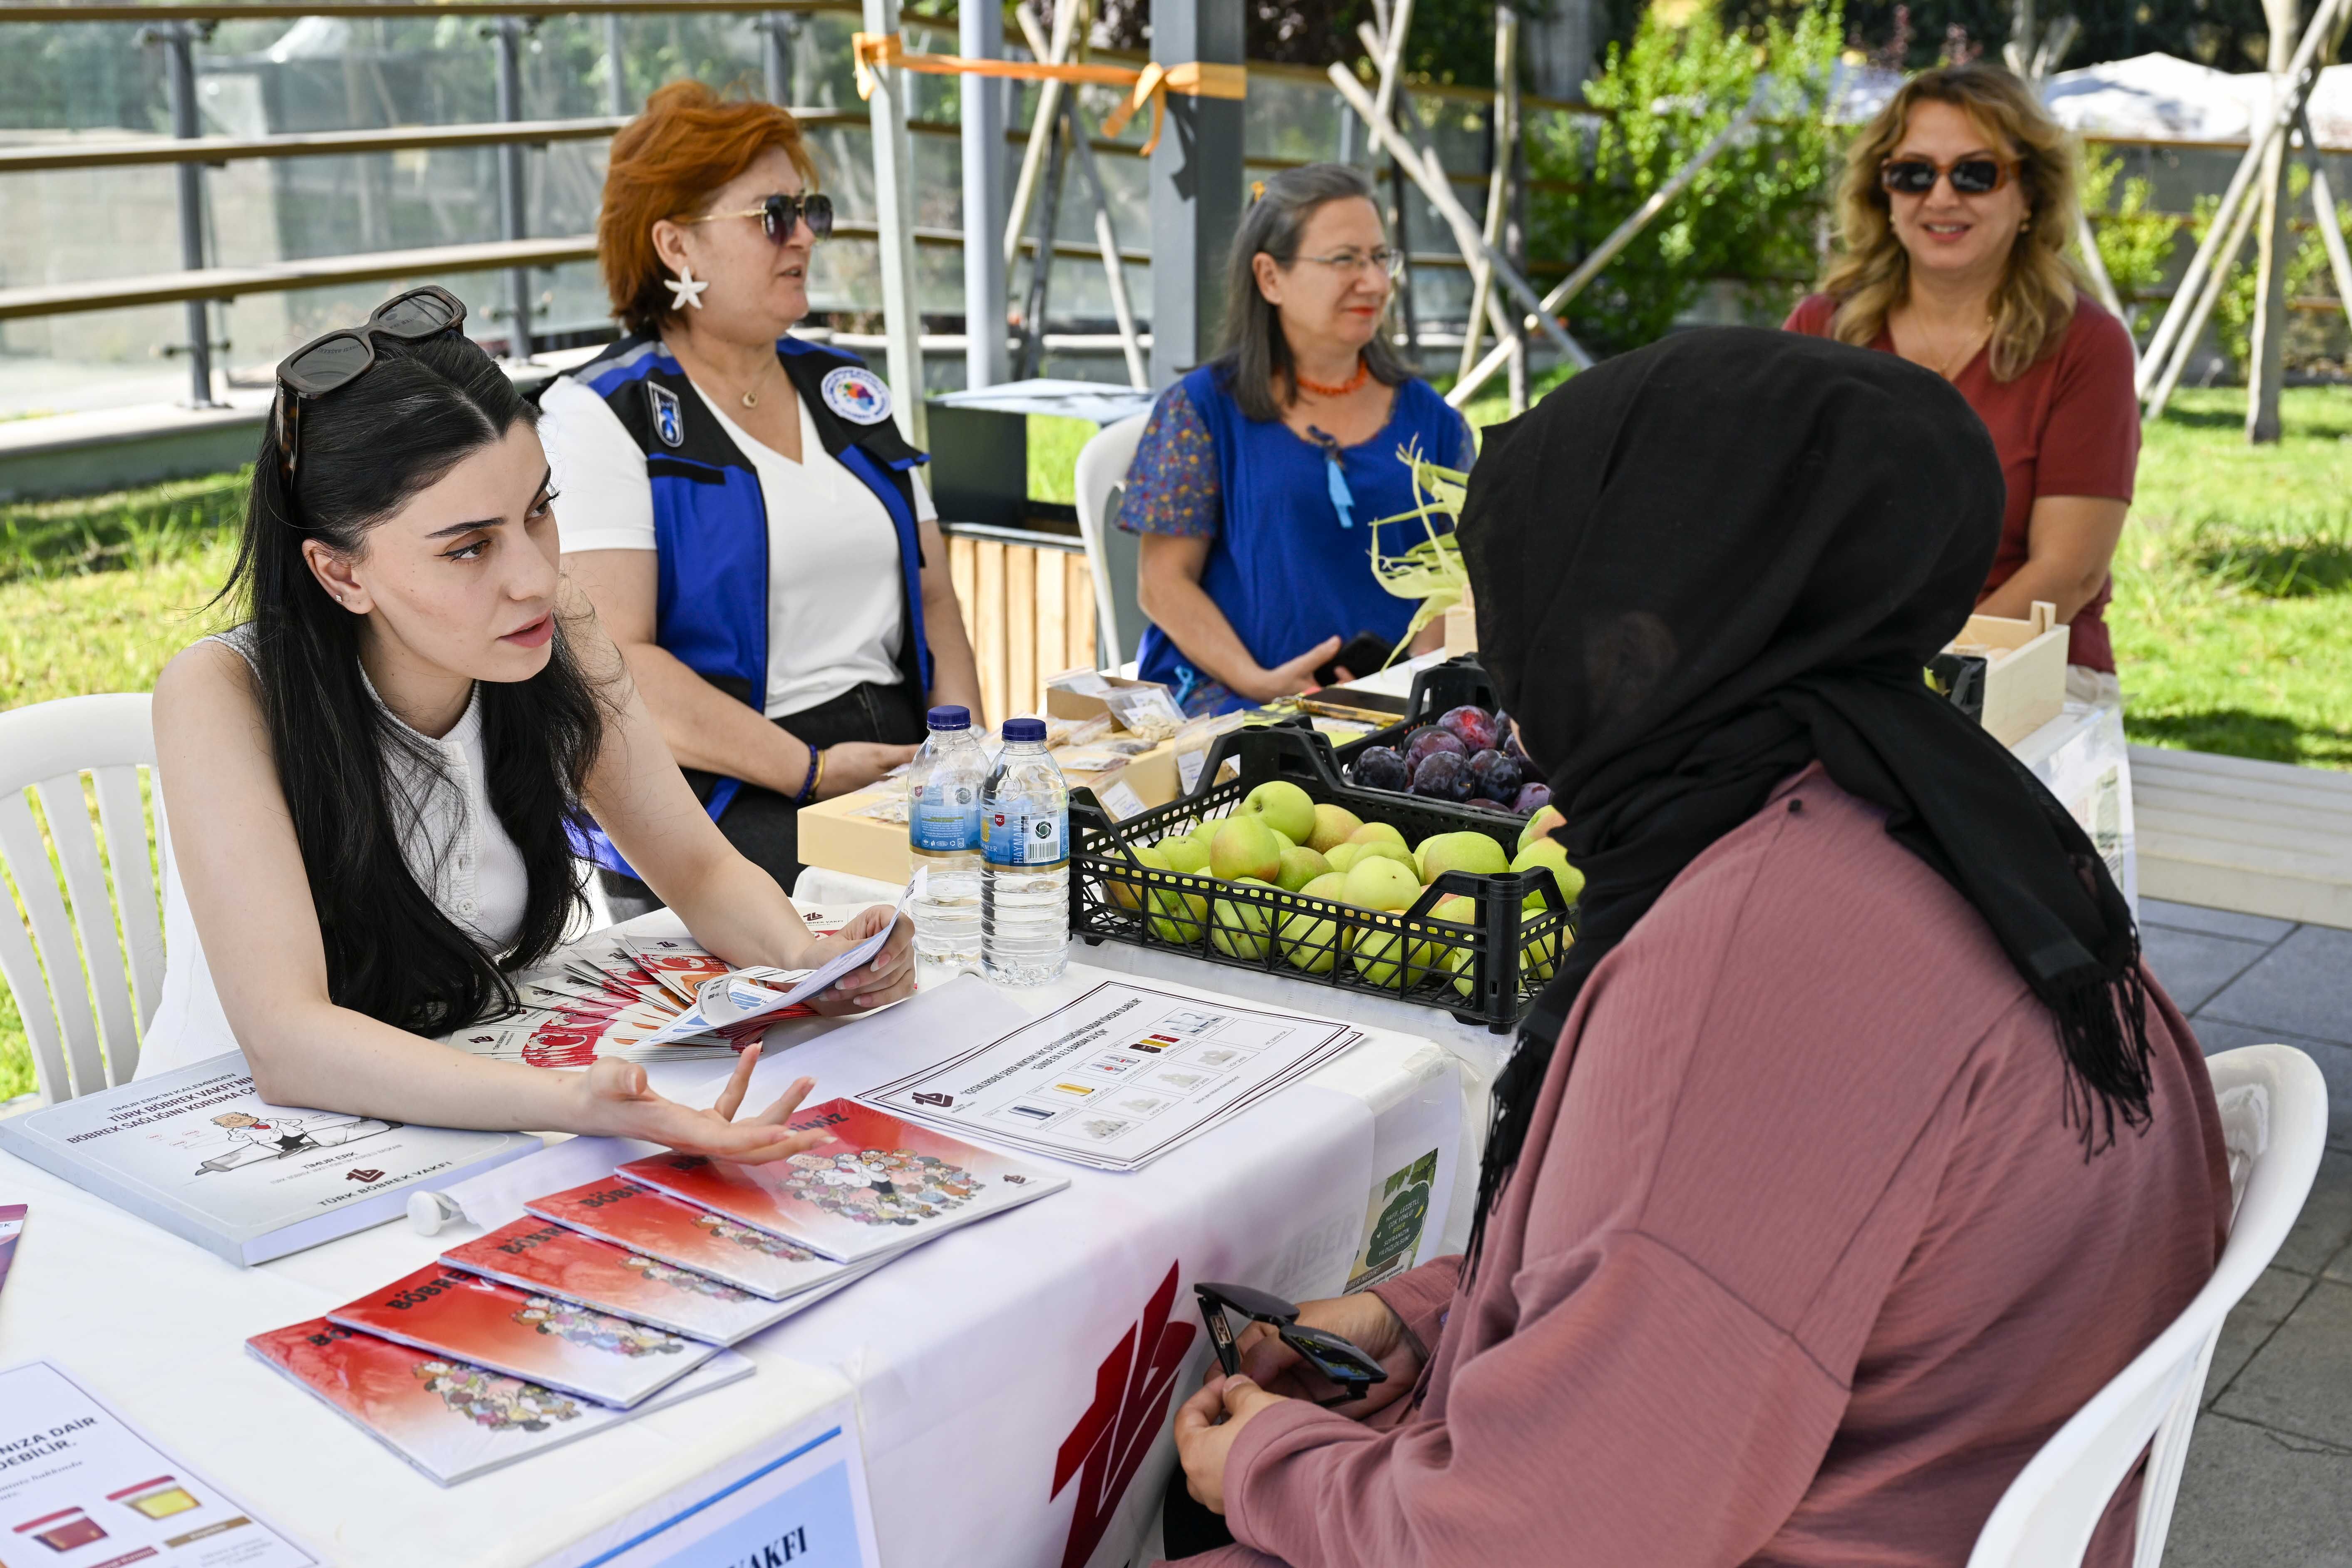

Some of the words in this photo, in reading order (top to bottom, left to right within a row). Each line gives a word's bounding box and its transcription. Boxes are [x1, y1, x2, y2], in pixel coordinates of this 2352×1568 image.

[1013, 820, 1024, 864] HAYMANA
[997, 1066, 1023, 1076] ŞEKER
[1012, 1054, 1042, 1067] MİKTARI
[1040, 1028, 1092, 1051] DÜŞÜNMEDİĞİNİZ
[1082, 1020, 1106, 1030] KADAR
[1096, 1011, 1123, 1022] YÜKSEK
[1066, 1038, 1094, 1049] BARDAK
[107, 1101, 139, 1113] TİMUR
[141, 1092, 174, 1106] ERK'İN
[174, 1073, 236, 1096] KALEMİNDEN
[66, 1125, 124, 1144] BÖBREK
[121, 1107, 188, 1129] SAĞLIĞINI
[184, 1092, 243, 1111] KORUMA
[107, 1109, 147, 1123] TÜRK
[145, 1094, 194, 1112] BÖBREK
[300, 1159, 335, 1170] TİMUR
[335, 1152, 357, 1161] ERK
[317, 1192, 357, 1206] TÜRK
[357, 1174, 413, 1195] BÖBREK
[412, 1161, 453, 1176] VAKFI
[1388, 1219, 1397, 1229] ÇOK
[1398, 1208, 1414, 1223] YÖNLÜ!
[1392, 1222, 1406, 1233] BİBER
[1384, 1227, 1410, 1246] SOFRANIZIN
[1361, 1266, 1381, 1283] NEDİR?
[49, 1417, 99, 1437] DAİR
